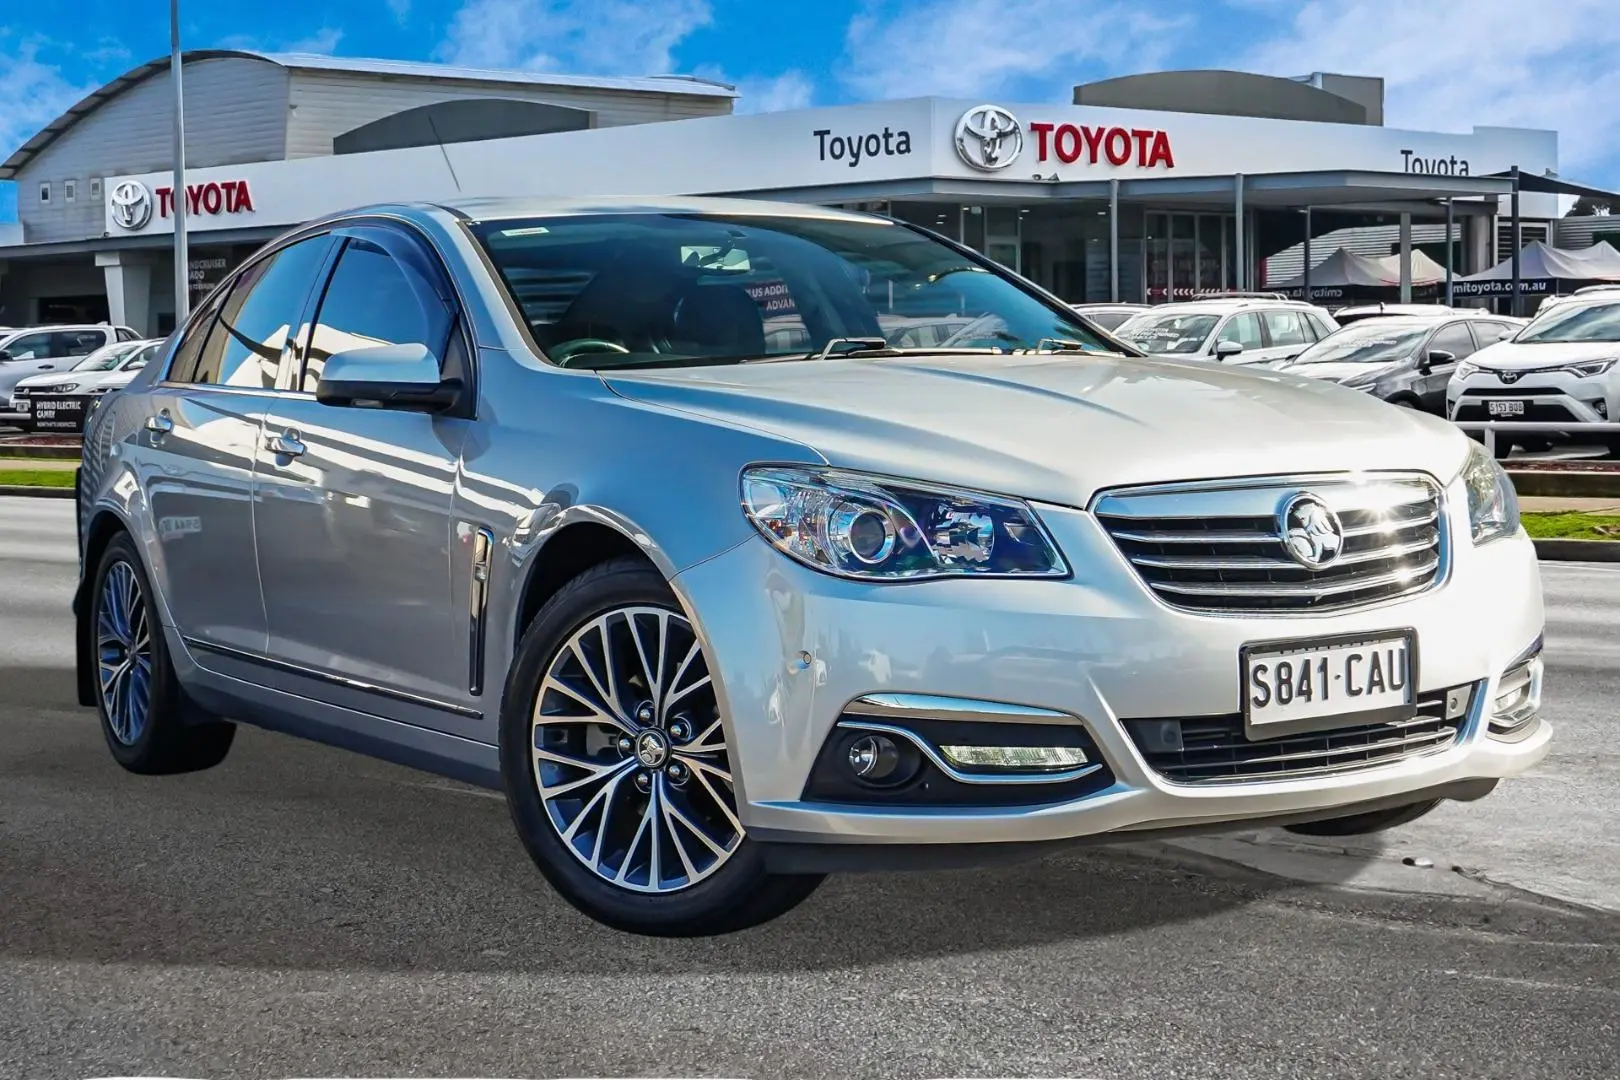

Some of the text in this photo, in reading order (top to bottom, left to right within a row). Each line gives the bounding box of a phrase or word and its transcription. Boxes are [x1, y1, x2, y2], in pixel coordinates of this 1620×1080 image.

[813, 127, 911, 167] Toyota
[1030, 122, 1175, 168] TOYOTA
[36, 401, 57, 410] HYBRID
[57, 401, 81, 410] ELECTRIC
